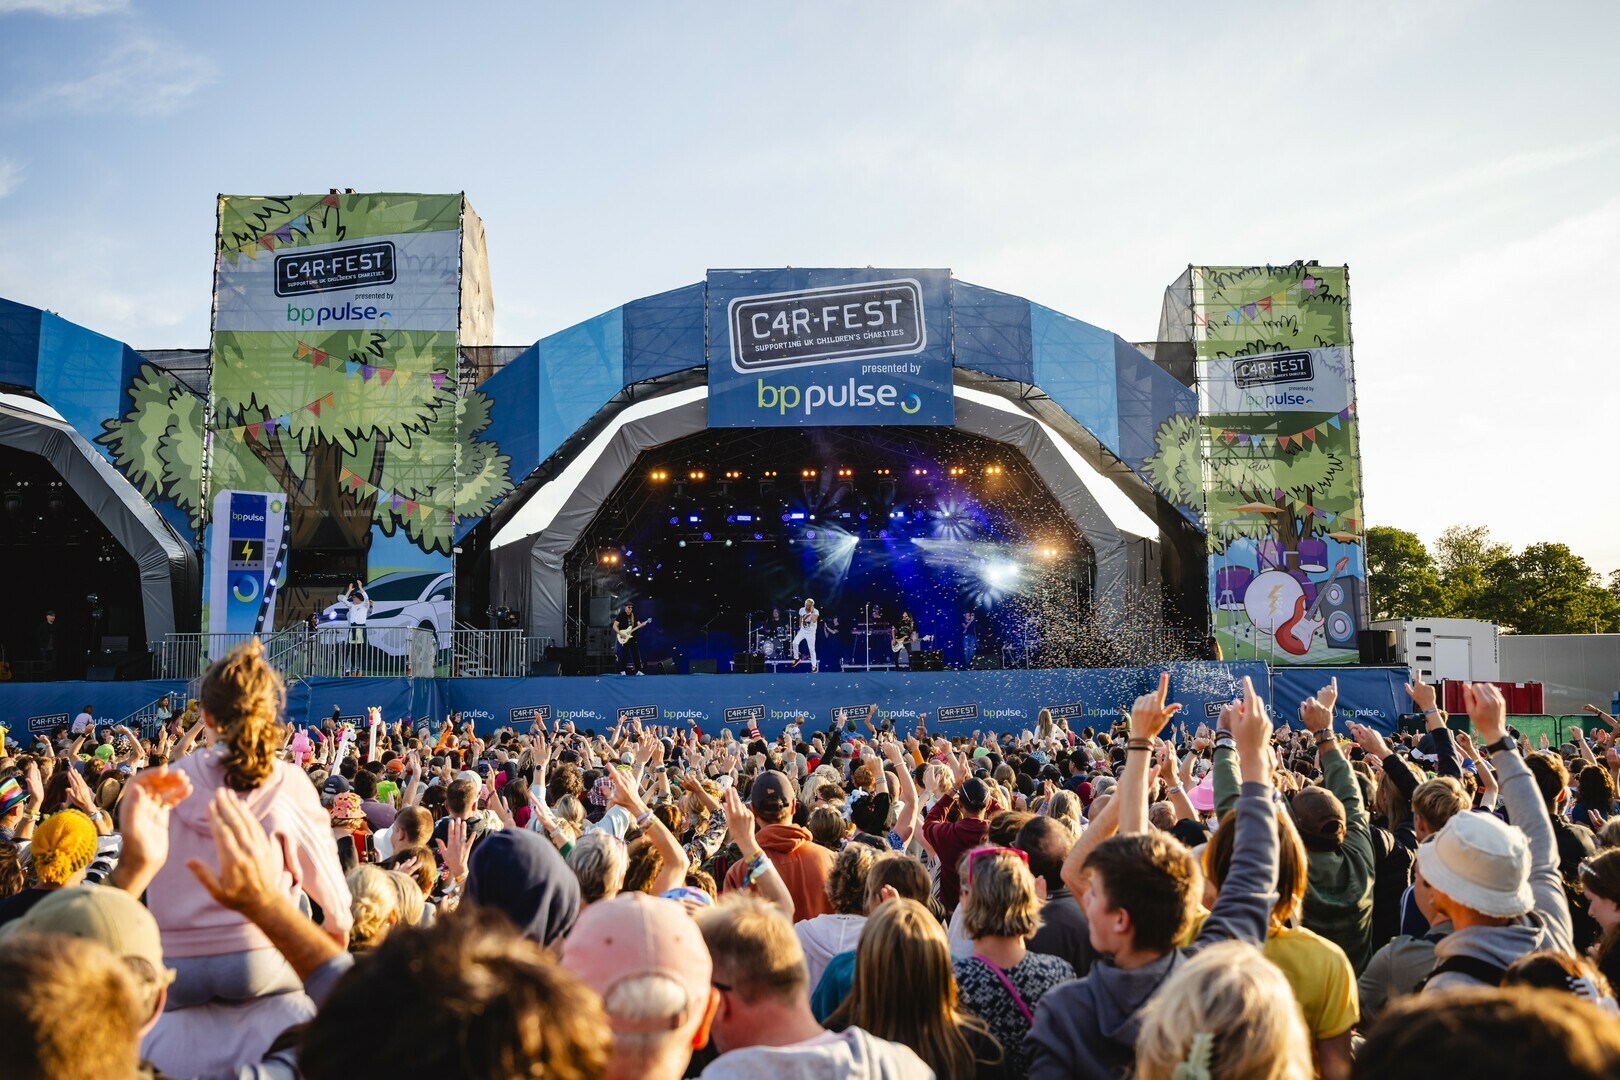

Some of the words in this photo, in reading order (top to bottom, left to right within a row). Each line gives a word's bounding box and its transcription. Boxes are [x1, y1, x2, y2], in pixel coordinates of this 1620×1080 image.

[286, 252, 385, 279] C4R-FEST
[751, 299, 902, 339] C4R-FEST
[755, 340, 802, 352] SUPPORTING
[816, 334, 861, 344] CHILDREN'S
[864, 328, 904, 339] CHARITIES
[862, 363, 908, 375] presented
[910, 364, 921, 376] by
[1241, 358, 1305, 376] C4R-FEST
[834, 707, 868, 716] CR-FEST
[1050, 706, 1078, 714] 4R-FEST
[1100, 707, 1119, 718] puls
